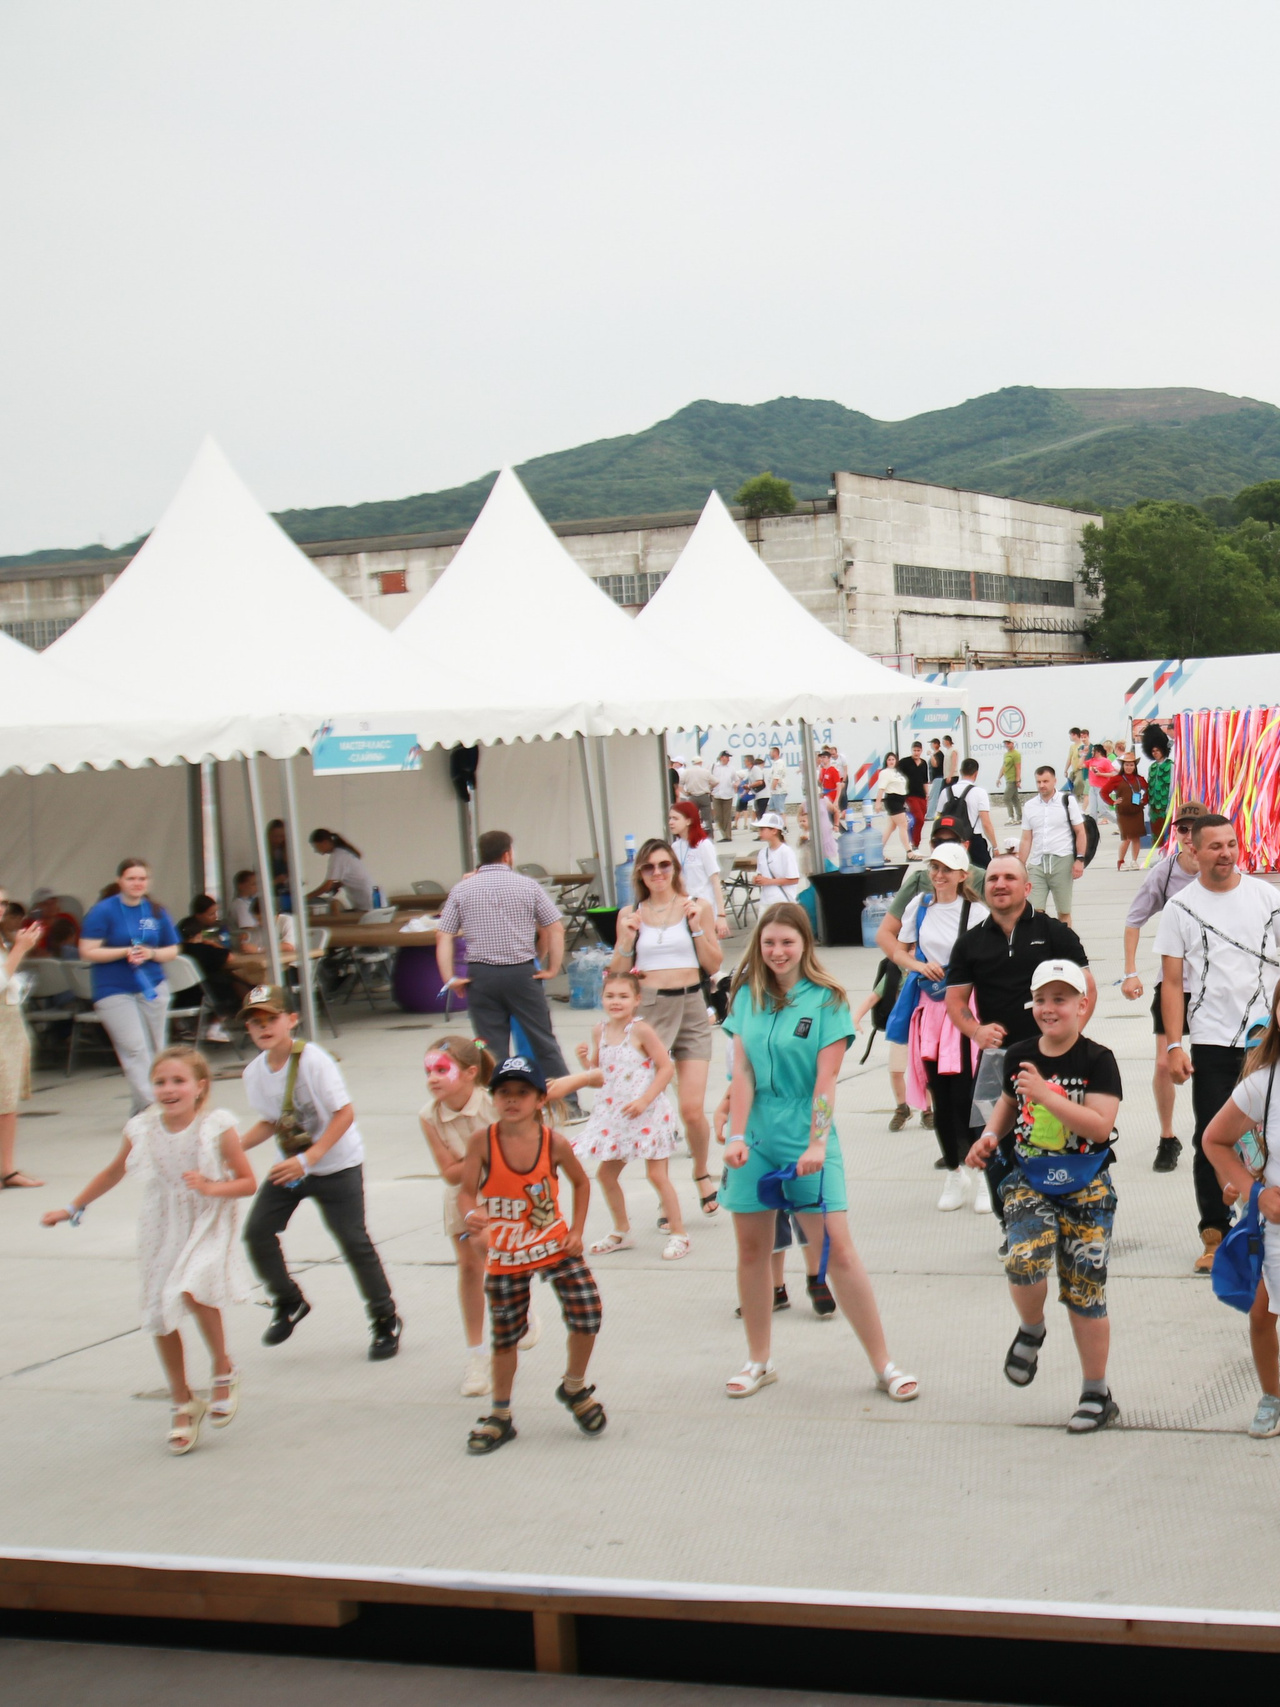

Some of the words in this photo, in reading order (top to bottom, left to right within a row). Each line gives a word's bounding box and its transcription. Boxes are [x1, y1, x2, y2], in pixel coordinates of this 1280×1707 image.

[975, 705, 1026, 739] 50
[728, 728, 833, 749] СОЗДААЯ
[969, 742, 1019, 752] ОСТОЧНЙ
[1021, 741, 1043, 750] ПОРТ
[1181, 806, 1200, 816] NYC
[1047, 1168, 1068, 1183] 50
[484, 1197, 527, 1221] EEP
[488, 1220, 563, 1251] The
[487, 1238, 562, 1267] PEACE
